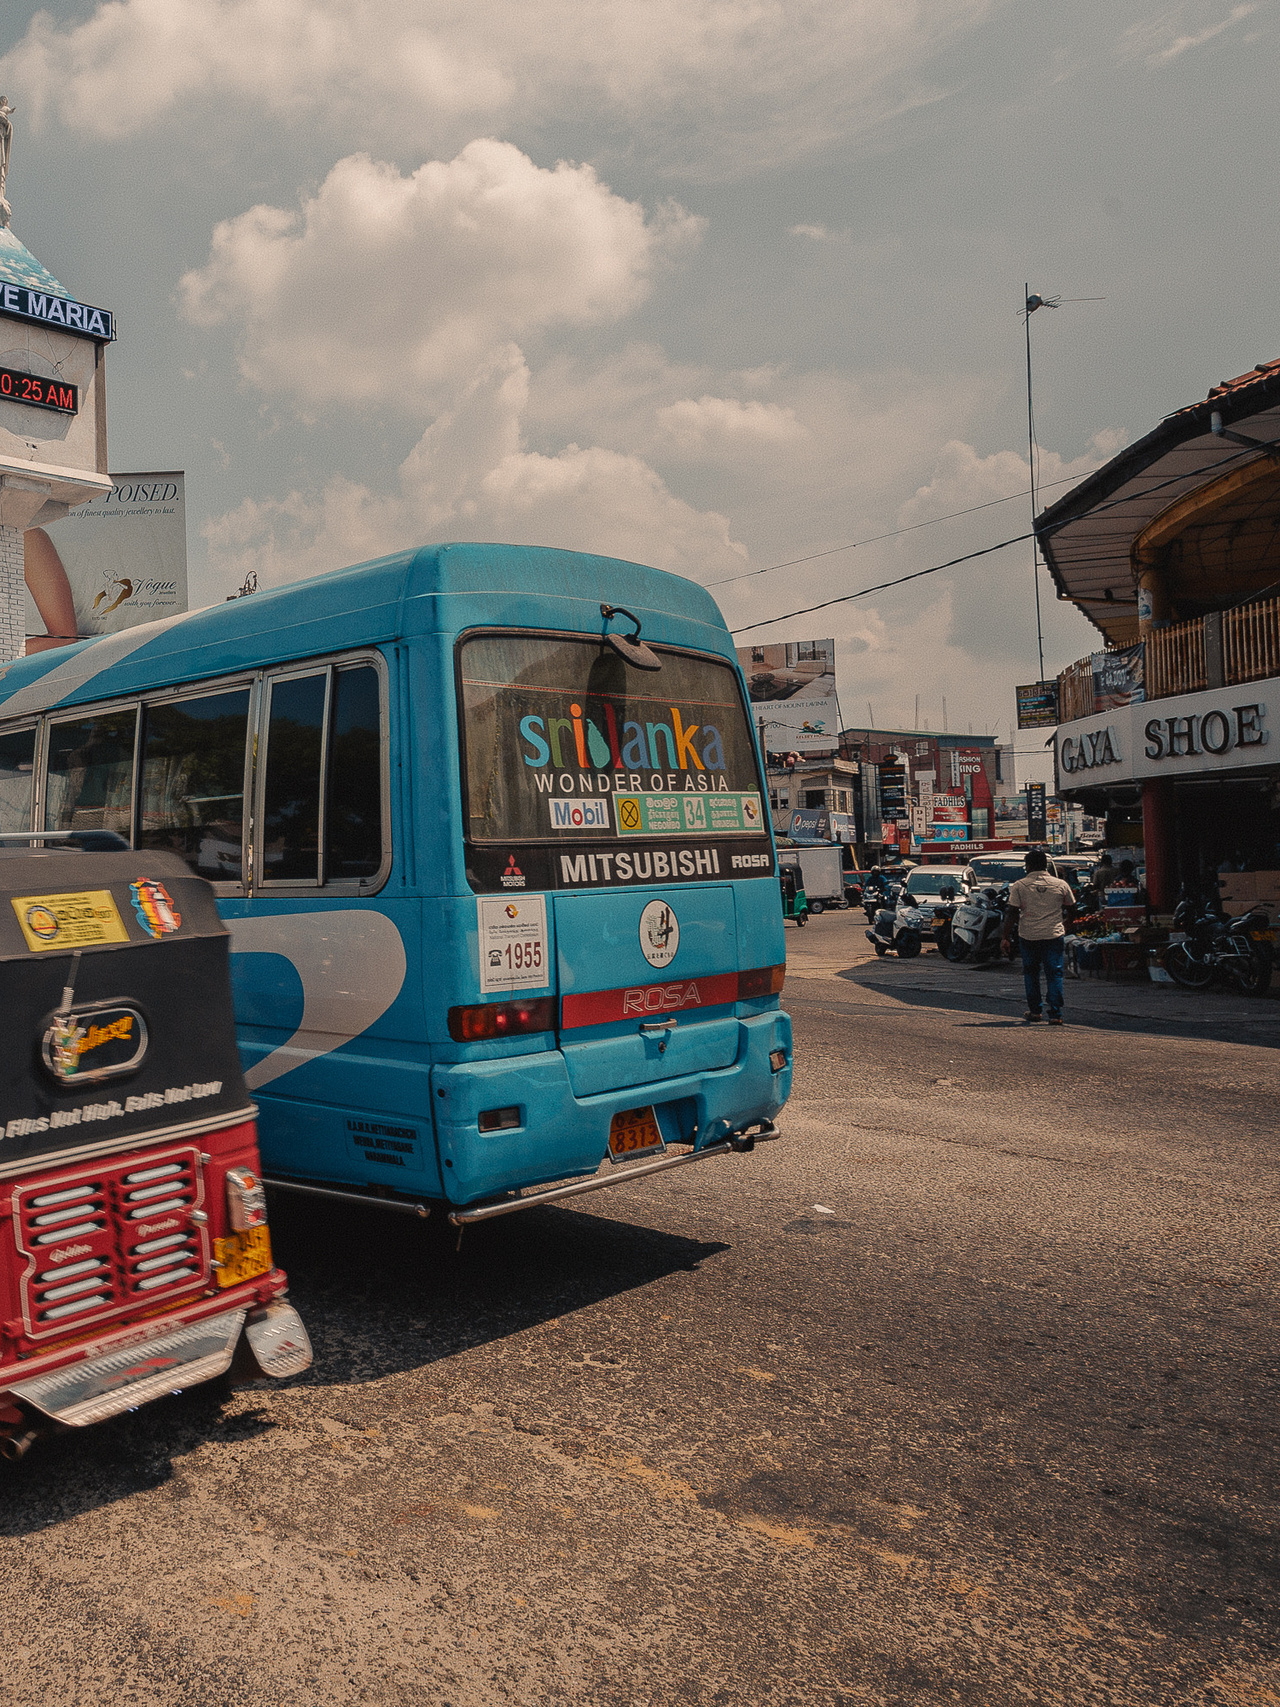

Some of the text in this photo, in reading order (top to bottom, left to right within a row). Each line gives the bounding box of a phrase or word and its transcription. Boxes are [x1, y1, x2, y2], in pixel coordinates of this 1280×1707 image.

[28, 290, 106, 334] MARIA
[46, 384, 74, 410] AM
[105, 482, 180, 504] POISED.
[102, 507, 126, 518] quality
[124, 506, 154, 518] jewellery
[154, 507, 162, 515] to
[132, 578, 177, 596] Vogue
[783, 702, 805, 710] MOUNT
[805, 700, 828, 708] LAVINIA
[1060, 702, 1268, 774] GAYA SHOE
[534, 773, 729, 793] WONDER OF ASIA
[686, 800, 705, 826] 34
[934, 796, 966, 807] FADHILS
[553, 802, 605, 826] Mobil
[648, 820, 681, 830] NEGOMBO
[801, 818, 818, 830] pepsi
[950, 843, 984, 851] FADHILS
[560, 848, 720, 883] MITSUBISHI
[731, 854, 770, 869] ROSA
[505, 941, 542, 970] 1955
[623, 981, 701, 1014] ROSA
[6, 1116, 50, 1138] Flies
[50, 1107, 82, 1129] Not
[125, 1091, 165, 1113] Falls
[164, 1084, 192, 1105] Not
[191, 1080, 223, 1100] Low
[615, 1123, 659, 1153] 8313
